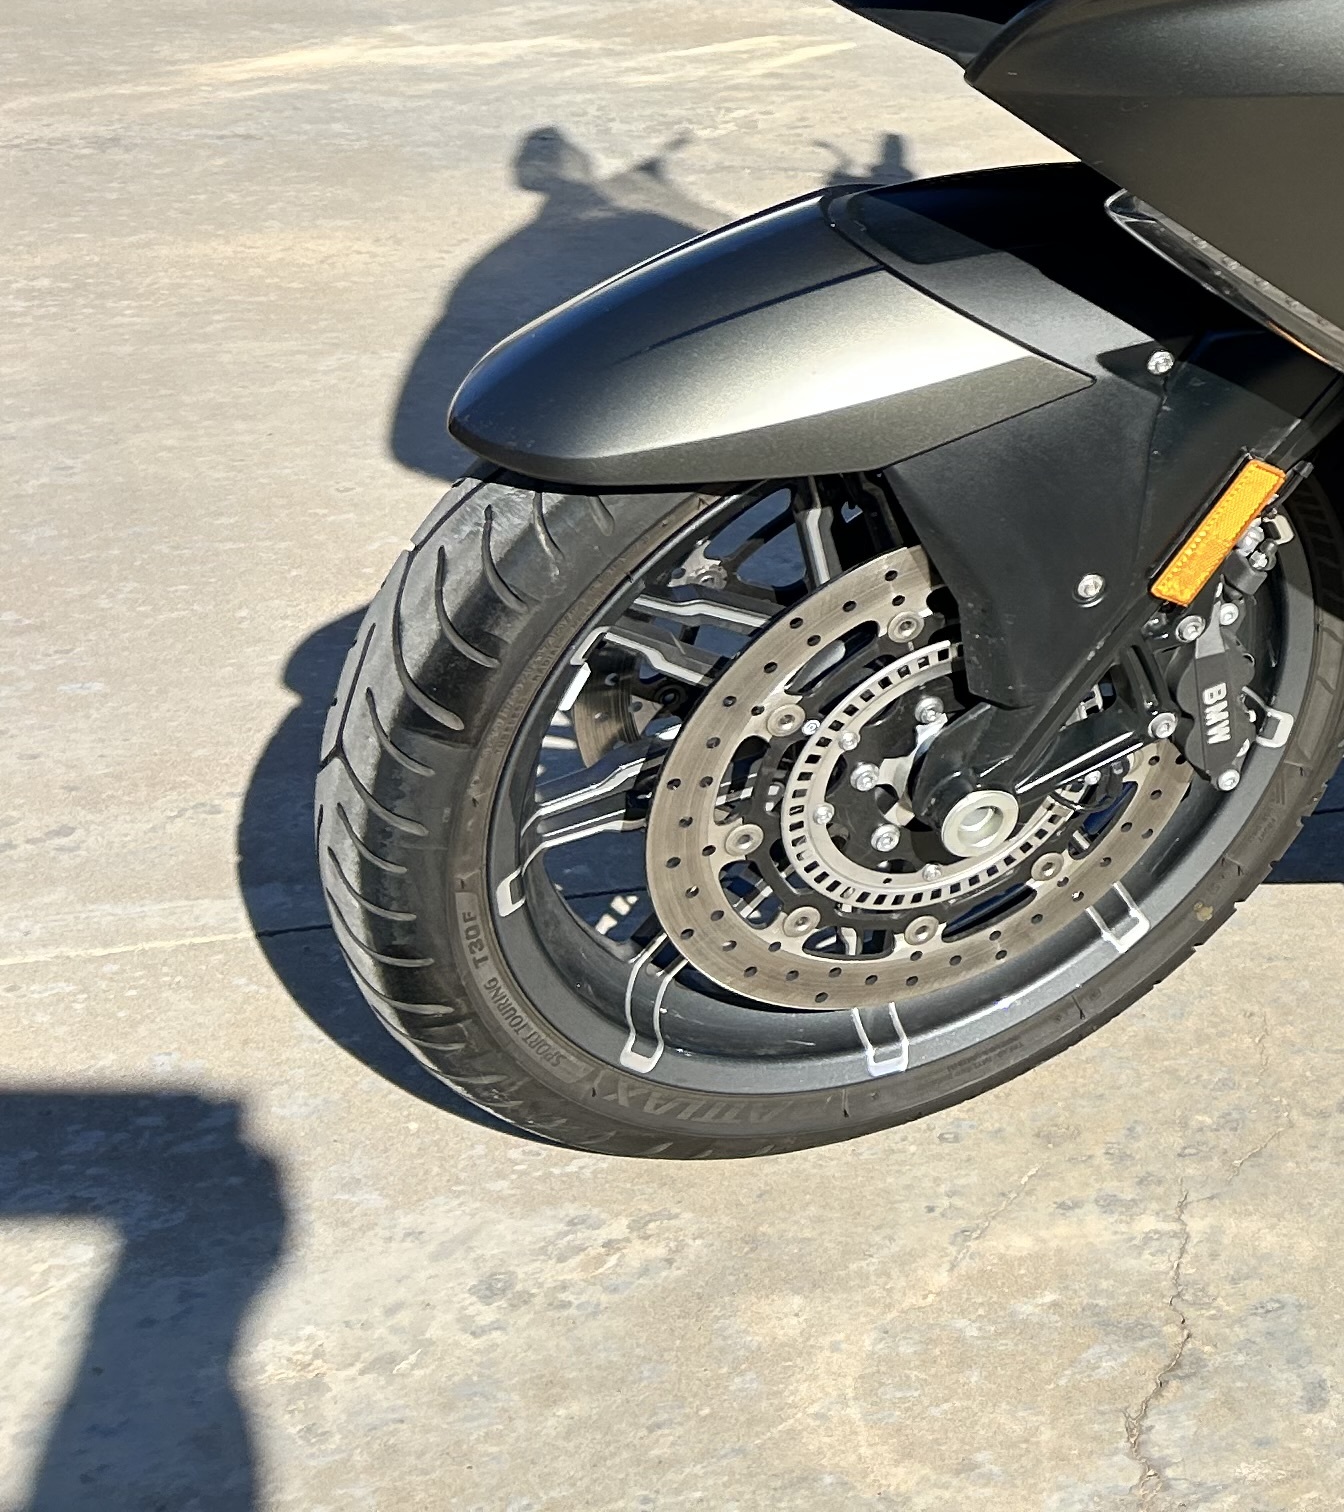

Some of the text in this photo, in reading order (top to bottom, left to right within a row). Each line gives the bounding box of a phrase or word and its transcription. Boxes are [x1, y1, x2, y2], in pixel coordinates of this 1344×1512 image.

[1202, 682, 1232, 745] BMW
[462, 911, 566, 1068] SPORT TOURING T30F
